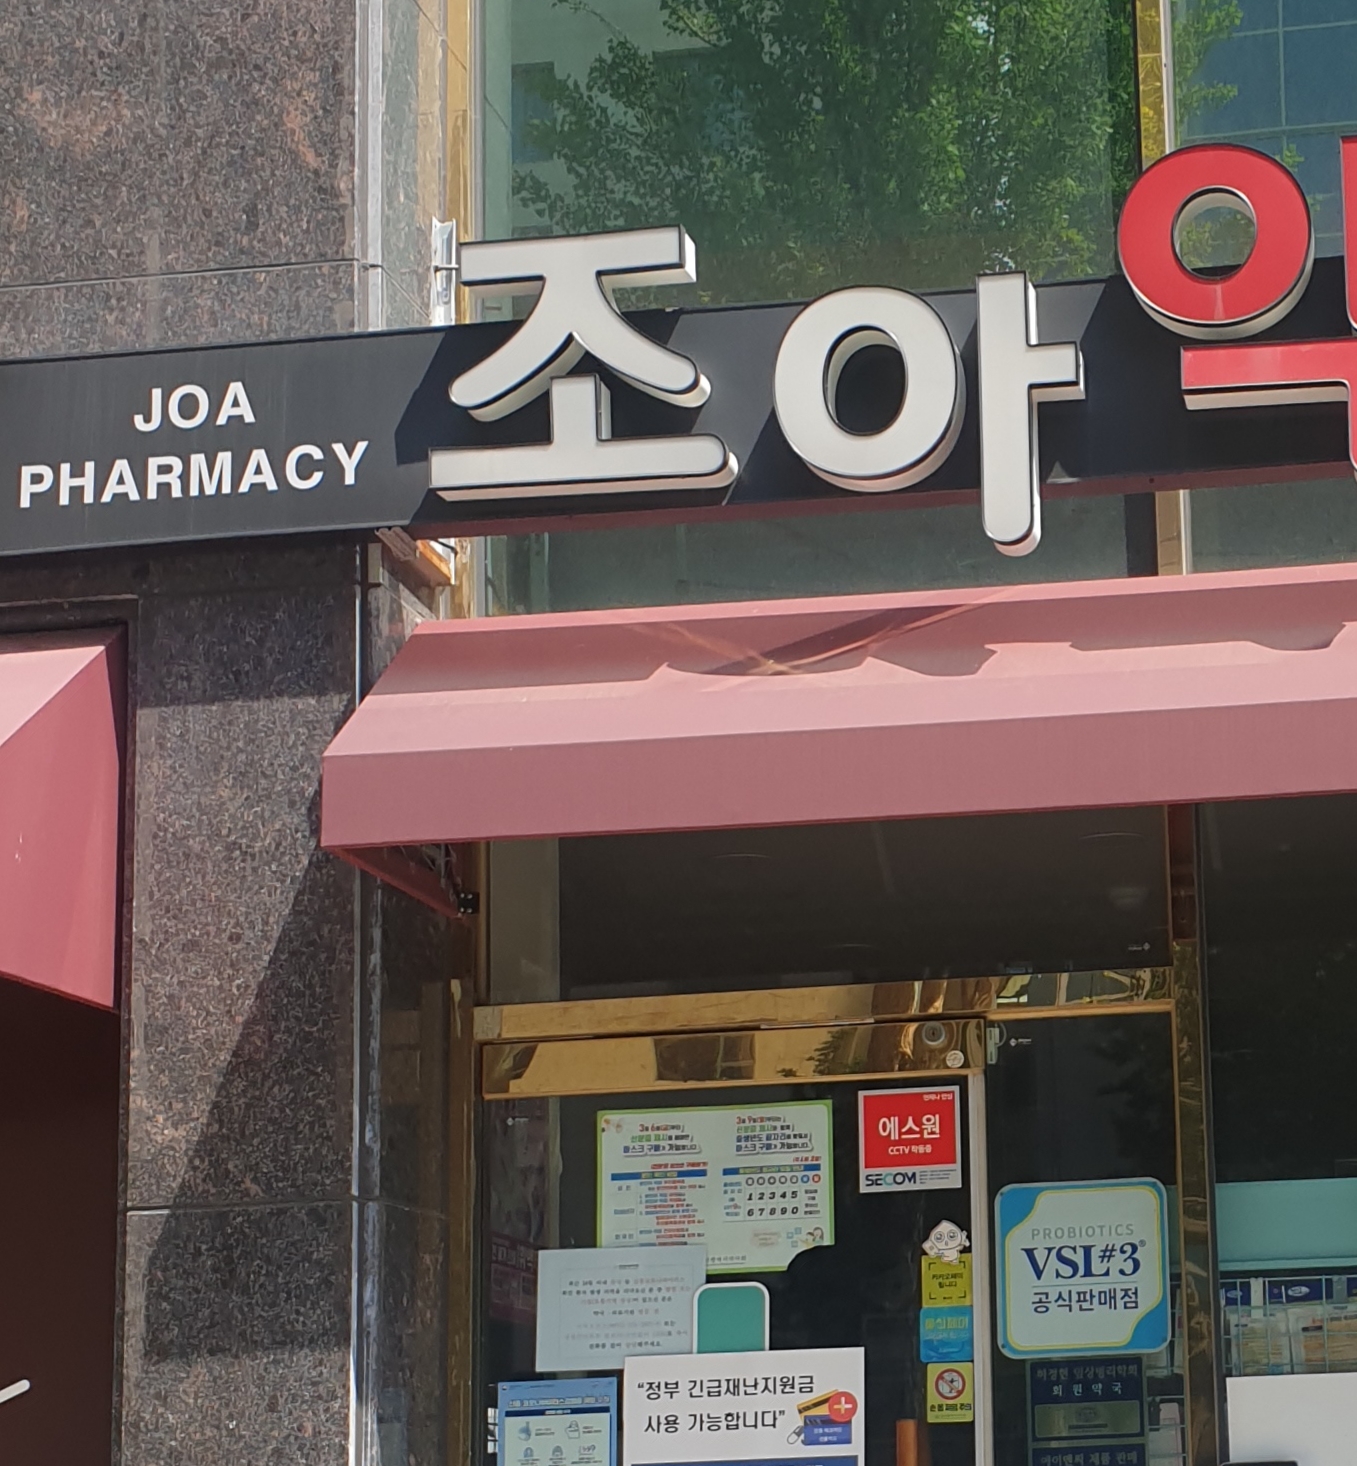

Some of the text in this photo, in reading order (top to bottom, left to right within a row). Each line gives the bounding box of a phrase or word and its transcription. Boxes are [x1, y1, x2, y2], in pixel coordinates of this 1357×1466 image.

[132, 380, 256, 433] JOA
[18, 440, 370, 509] PHARMACY
[878, 1113, 941, 1141] 에스원
[888, 1145, 910, 1155] CCTV
[865, 1172, 917, 1187] SECOM
[747, 1190, 799, 1201] 1 2 3 4 5
[747, 1206, 799, 1217] 6 7 8 9 0
[1031, 1223, 1135, 1240] PROBIOTICS
[1031, 1286, 1140, 1314] 공식판매점
[687, 1374, 815, 1398] 긴급재난지원금
[644, 1413, 680, 1435] 사용
